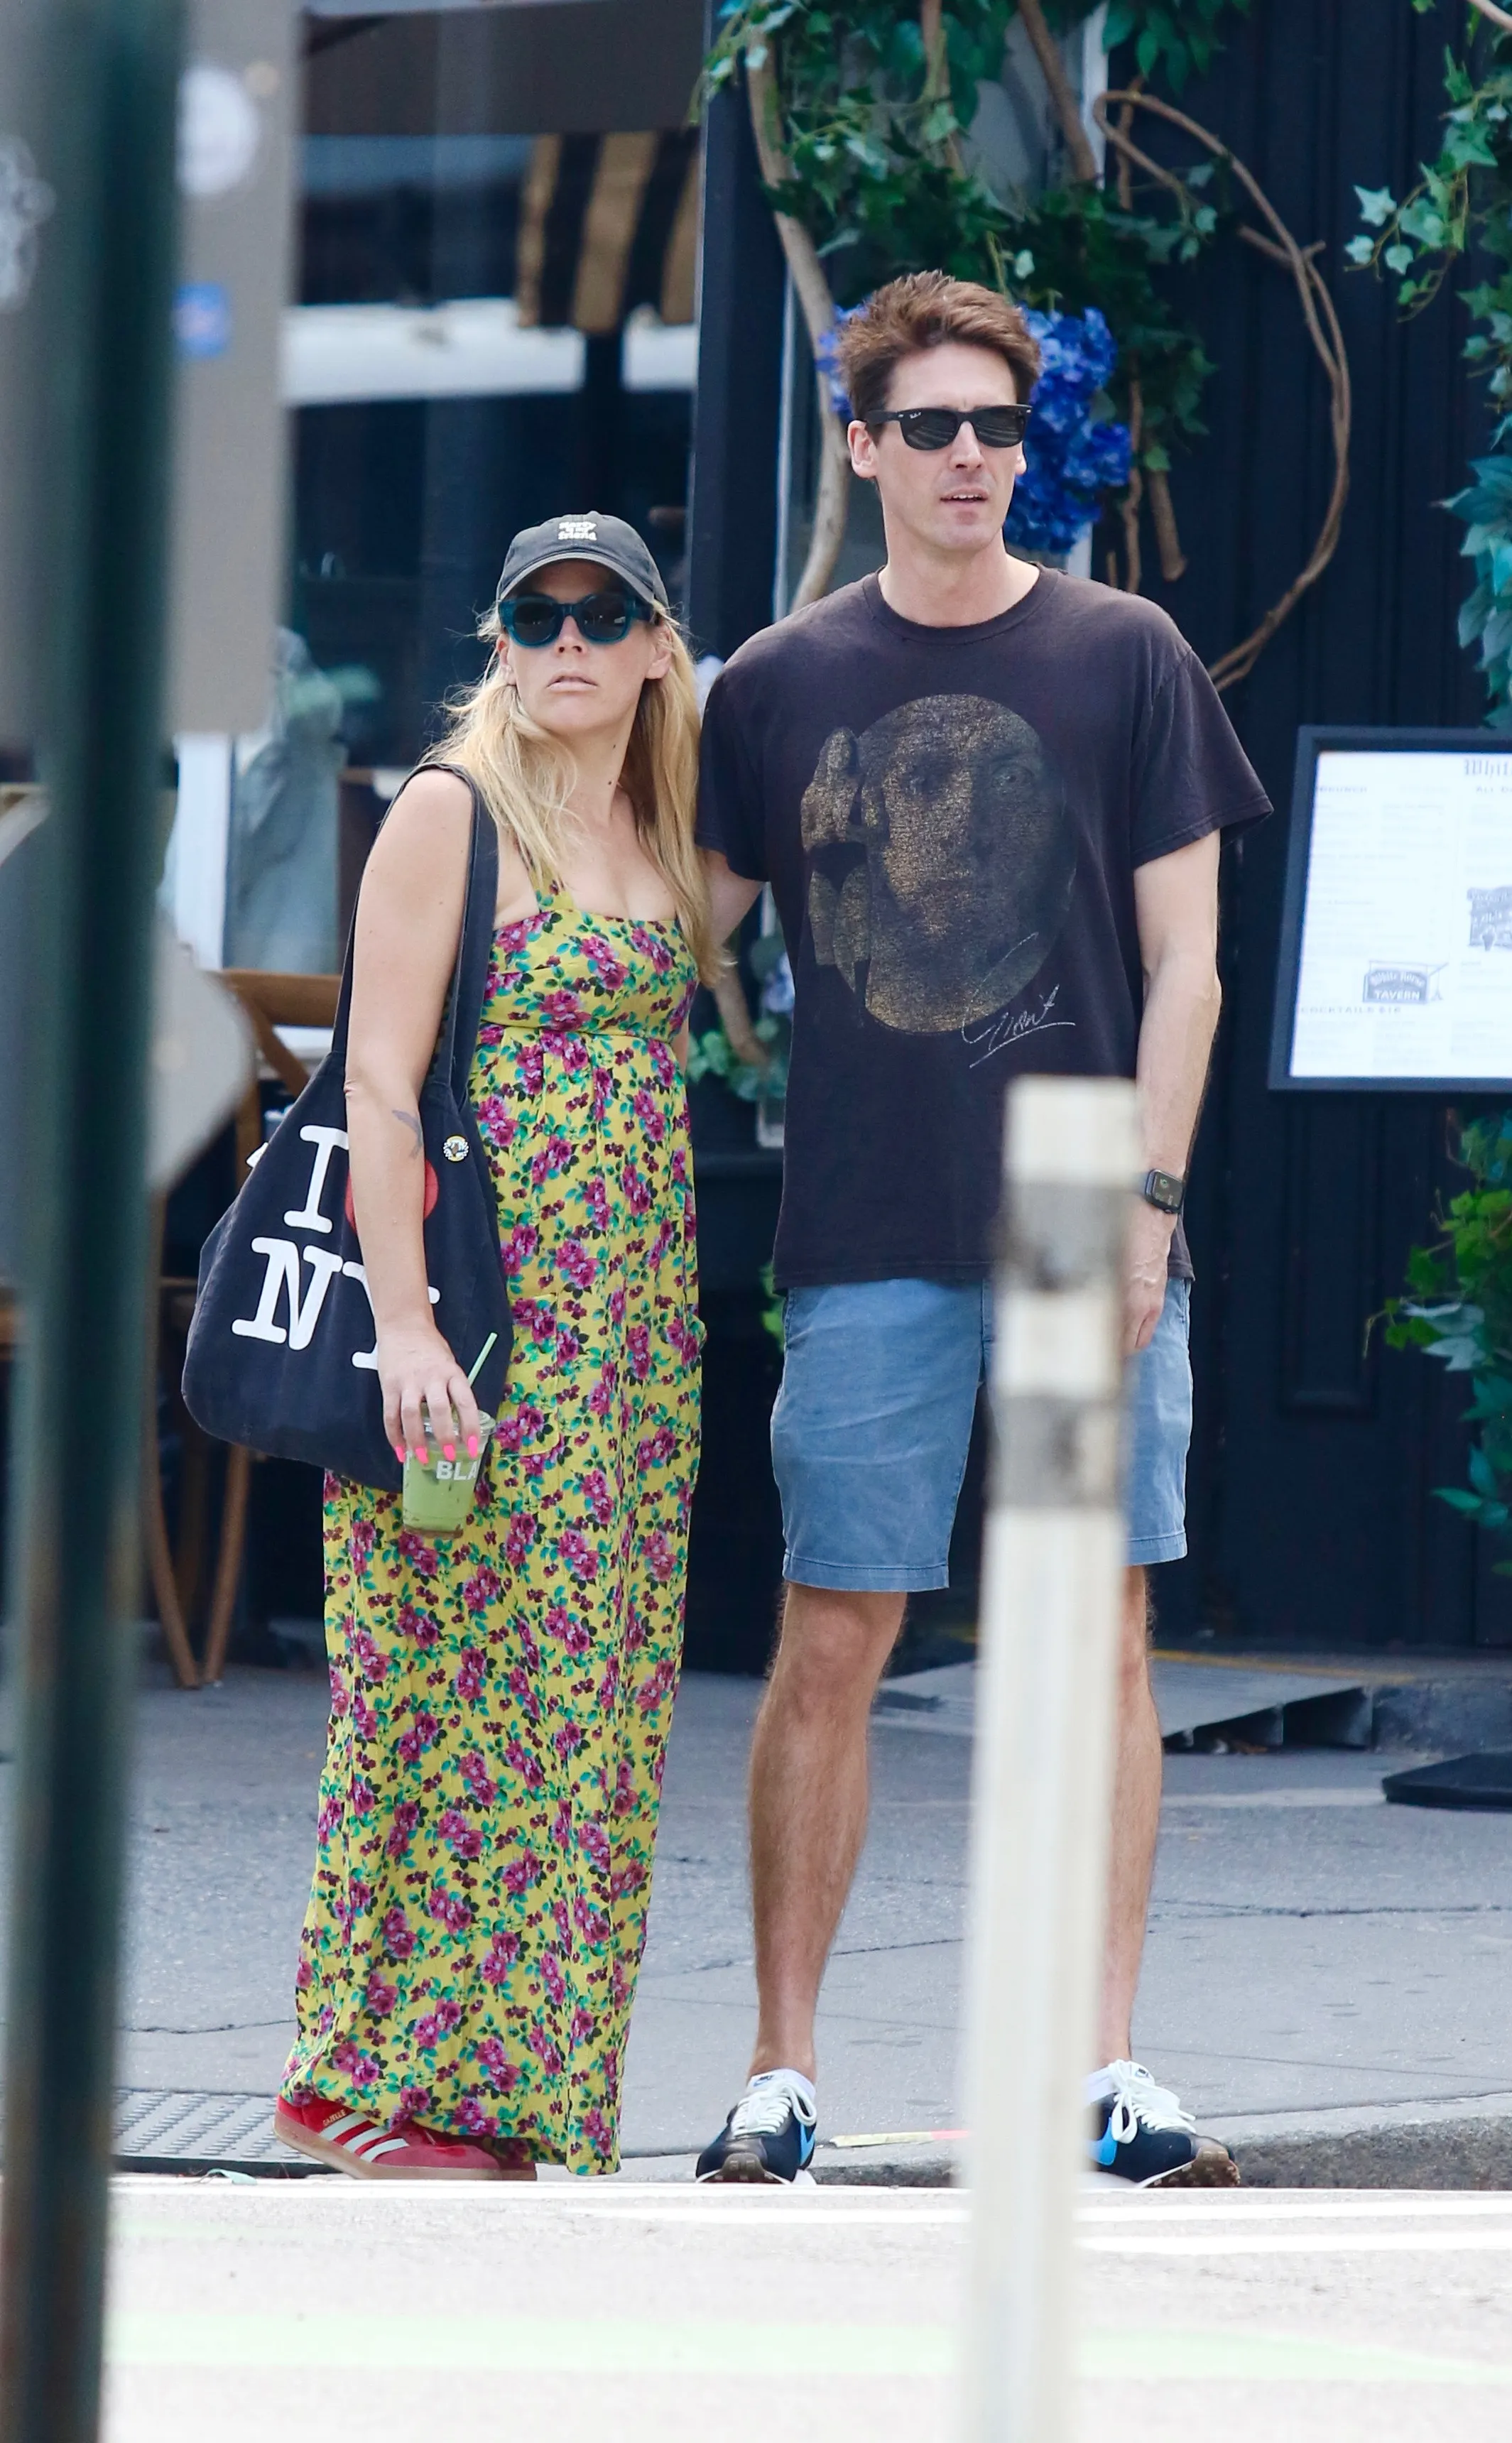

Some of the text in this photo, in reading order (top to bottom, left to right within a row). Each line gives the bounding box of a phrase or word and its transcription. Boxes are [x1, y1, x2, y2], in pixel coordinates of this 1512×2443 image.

[559, 531, 597, 540] friend
[1464, 758, 1512, 778] Whit
[1374, 989, 1420, 1001] TAVERN
[283, 1124, 349, 1234] I
